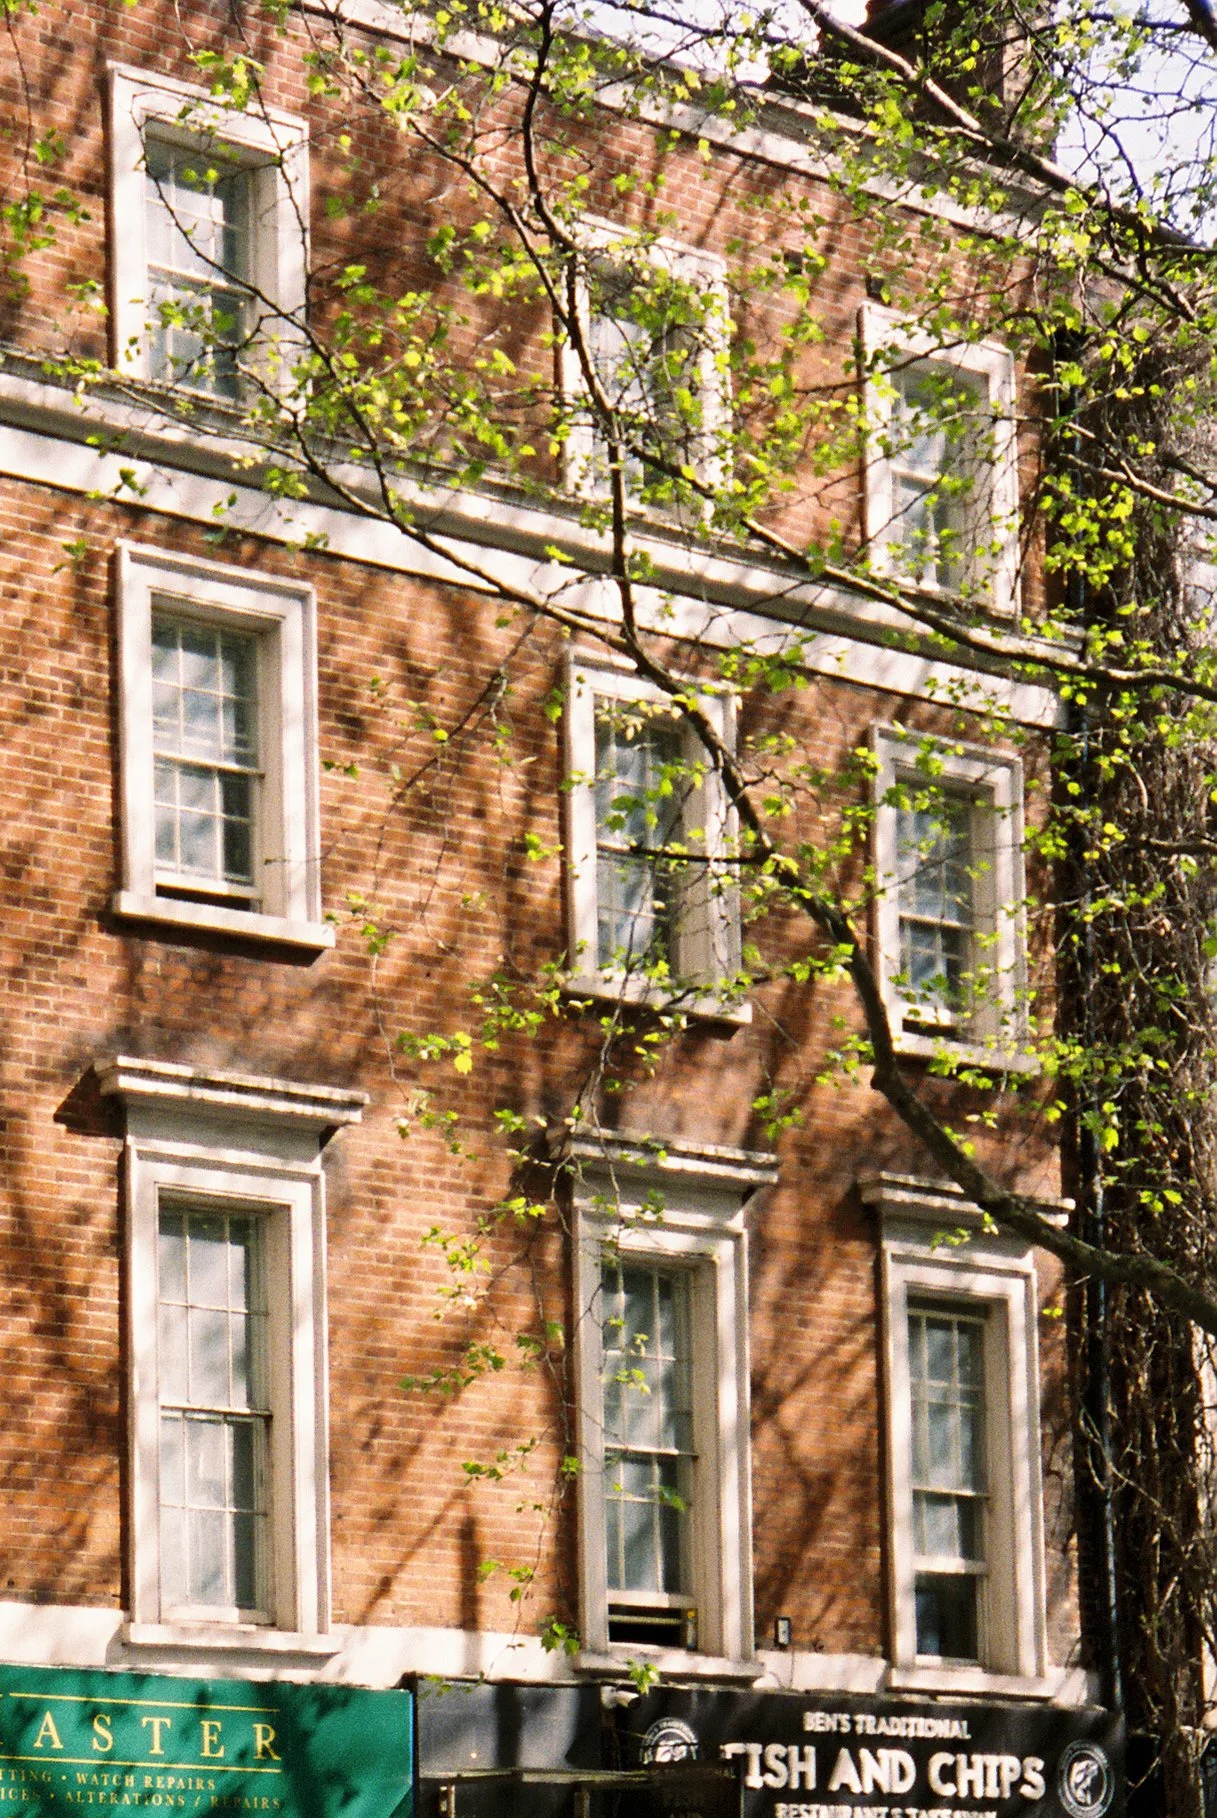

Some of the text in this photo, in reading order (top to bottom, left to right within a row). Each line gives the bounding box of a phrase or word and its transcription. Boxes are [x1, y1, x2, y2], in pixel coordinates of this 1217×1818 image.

[803, 1711, 972, 1740] BEN'S TRADITIONAL
[76, 1771, 135, 1787] WATCH
[143, 1775, 216, 1790] REPAIRS
[827, 1747, 917, 1794] AND
[928, 1752, 1046, 1801] CHIPS
[64, 1790, 185, 1808] ALTERATIONS
